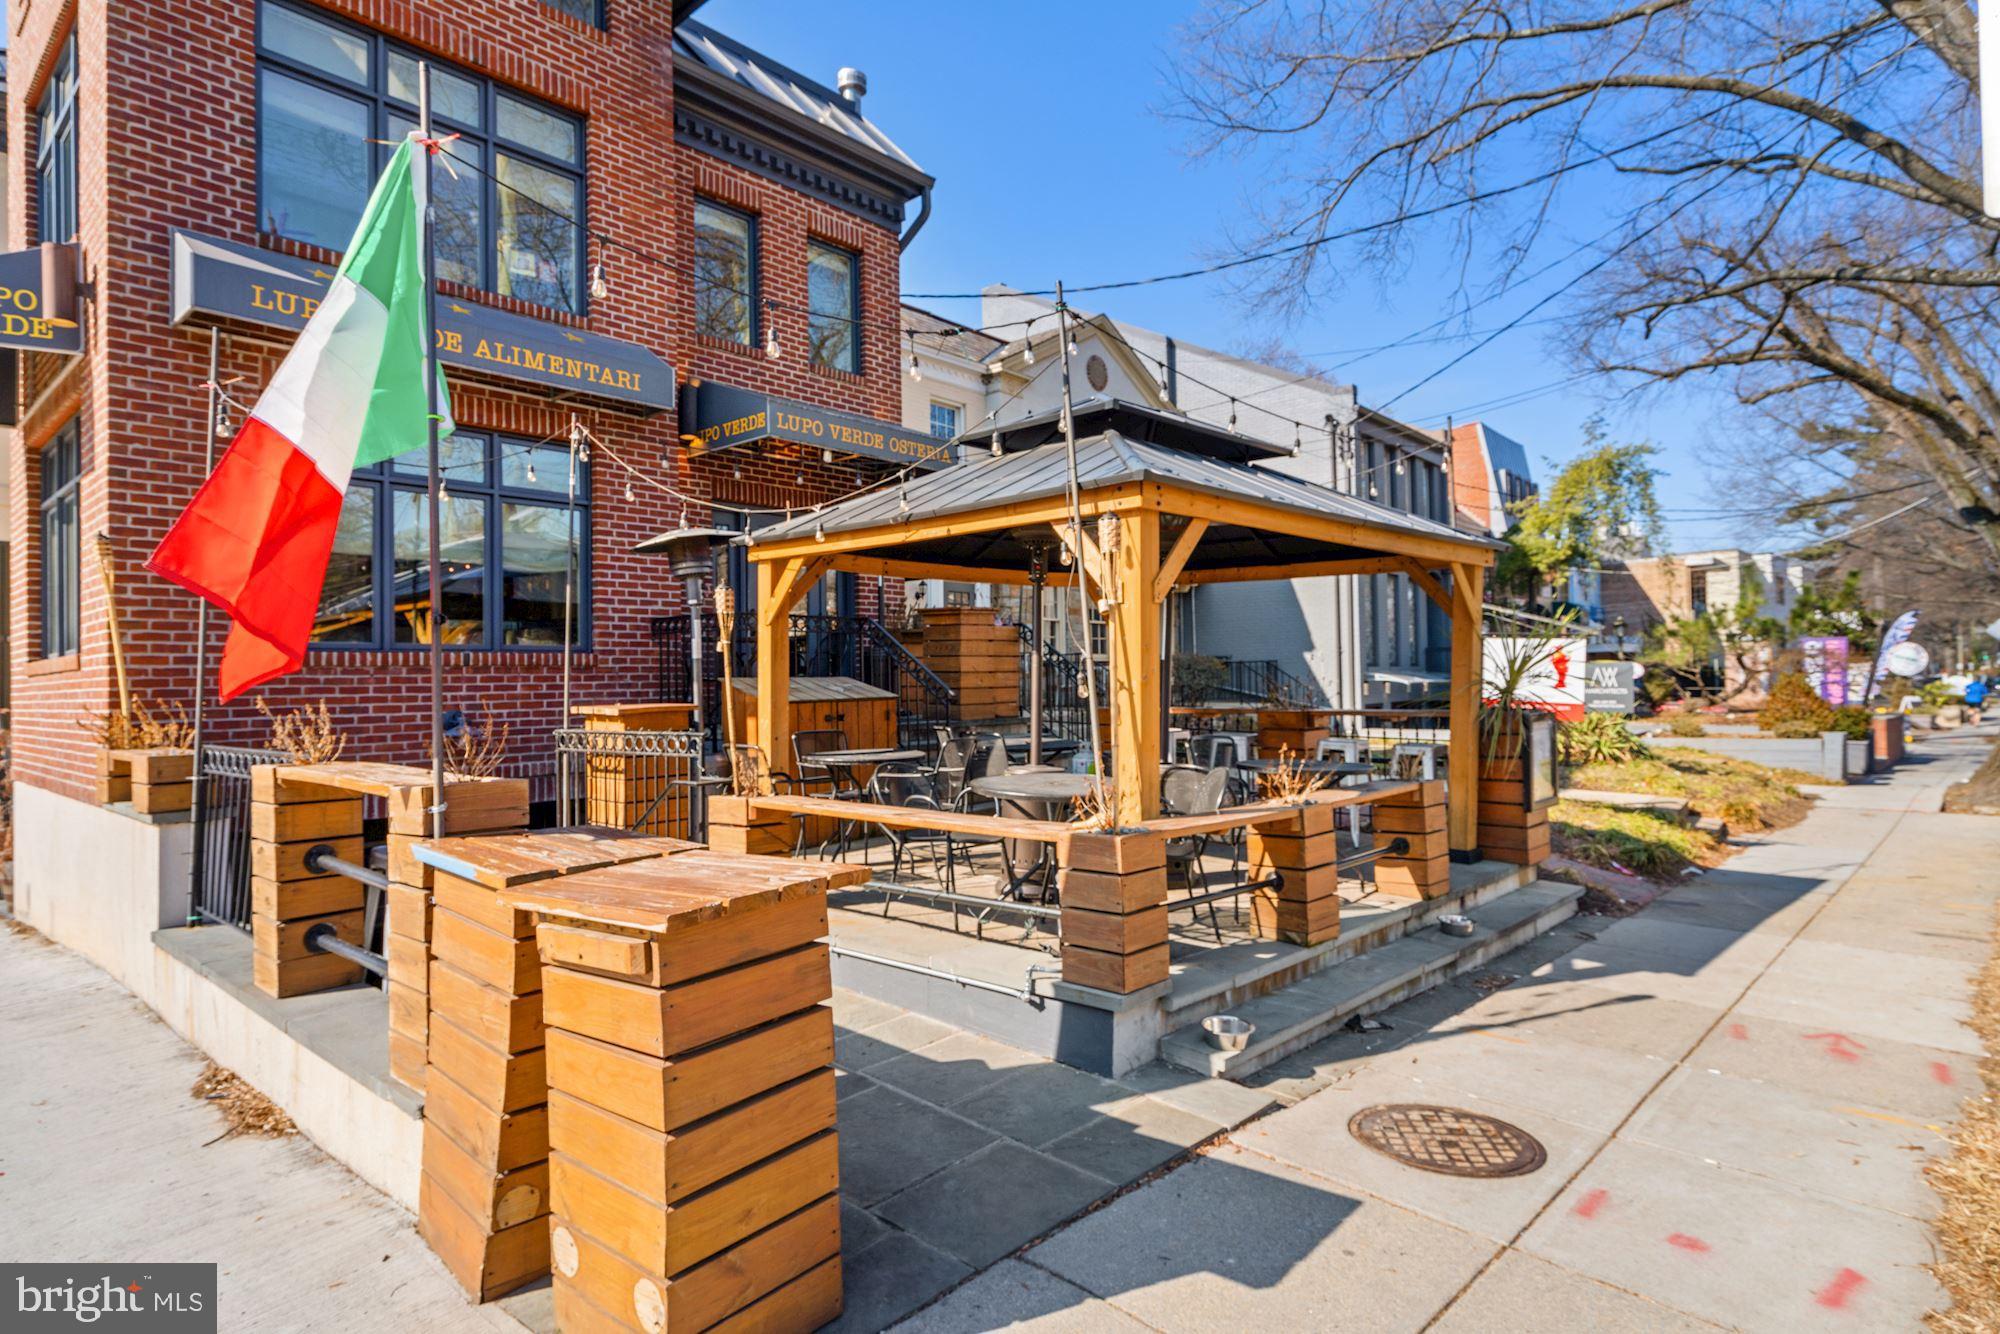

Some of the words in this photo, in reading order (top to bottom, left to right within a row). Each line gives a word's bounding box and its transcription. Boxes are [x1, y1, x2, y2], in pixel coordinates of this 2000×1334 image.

[250, 284, 321, 319] LUP
[473, 339, 642, 392] ALIMENTARI
[722, 412, 766, 437] VERDE
[776, 412, 824, 437] LUPO
[828, 423, 884, 450] VERDE
[889, 437, 952, 464] OSTERIA
